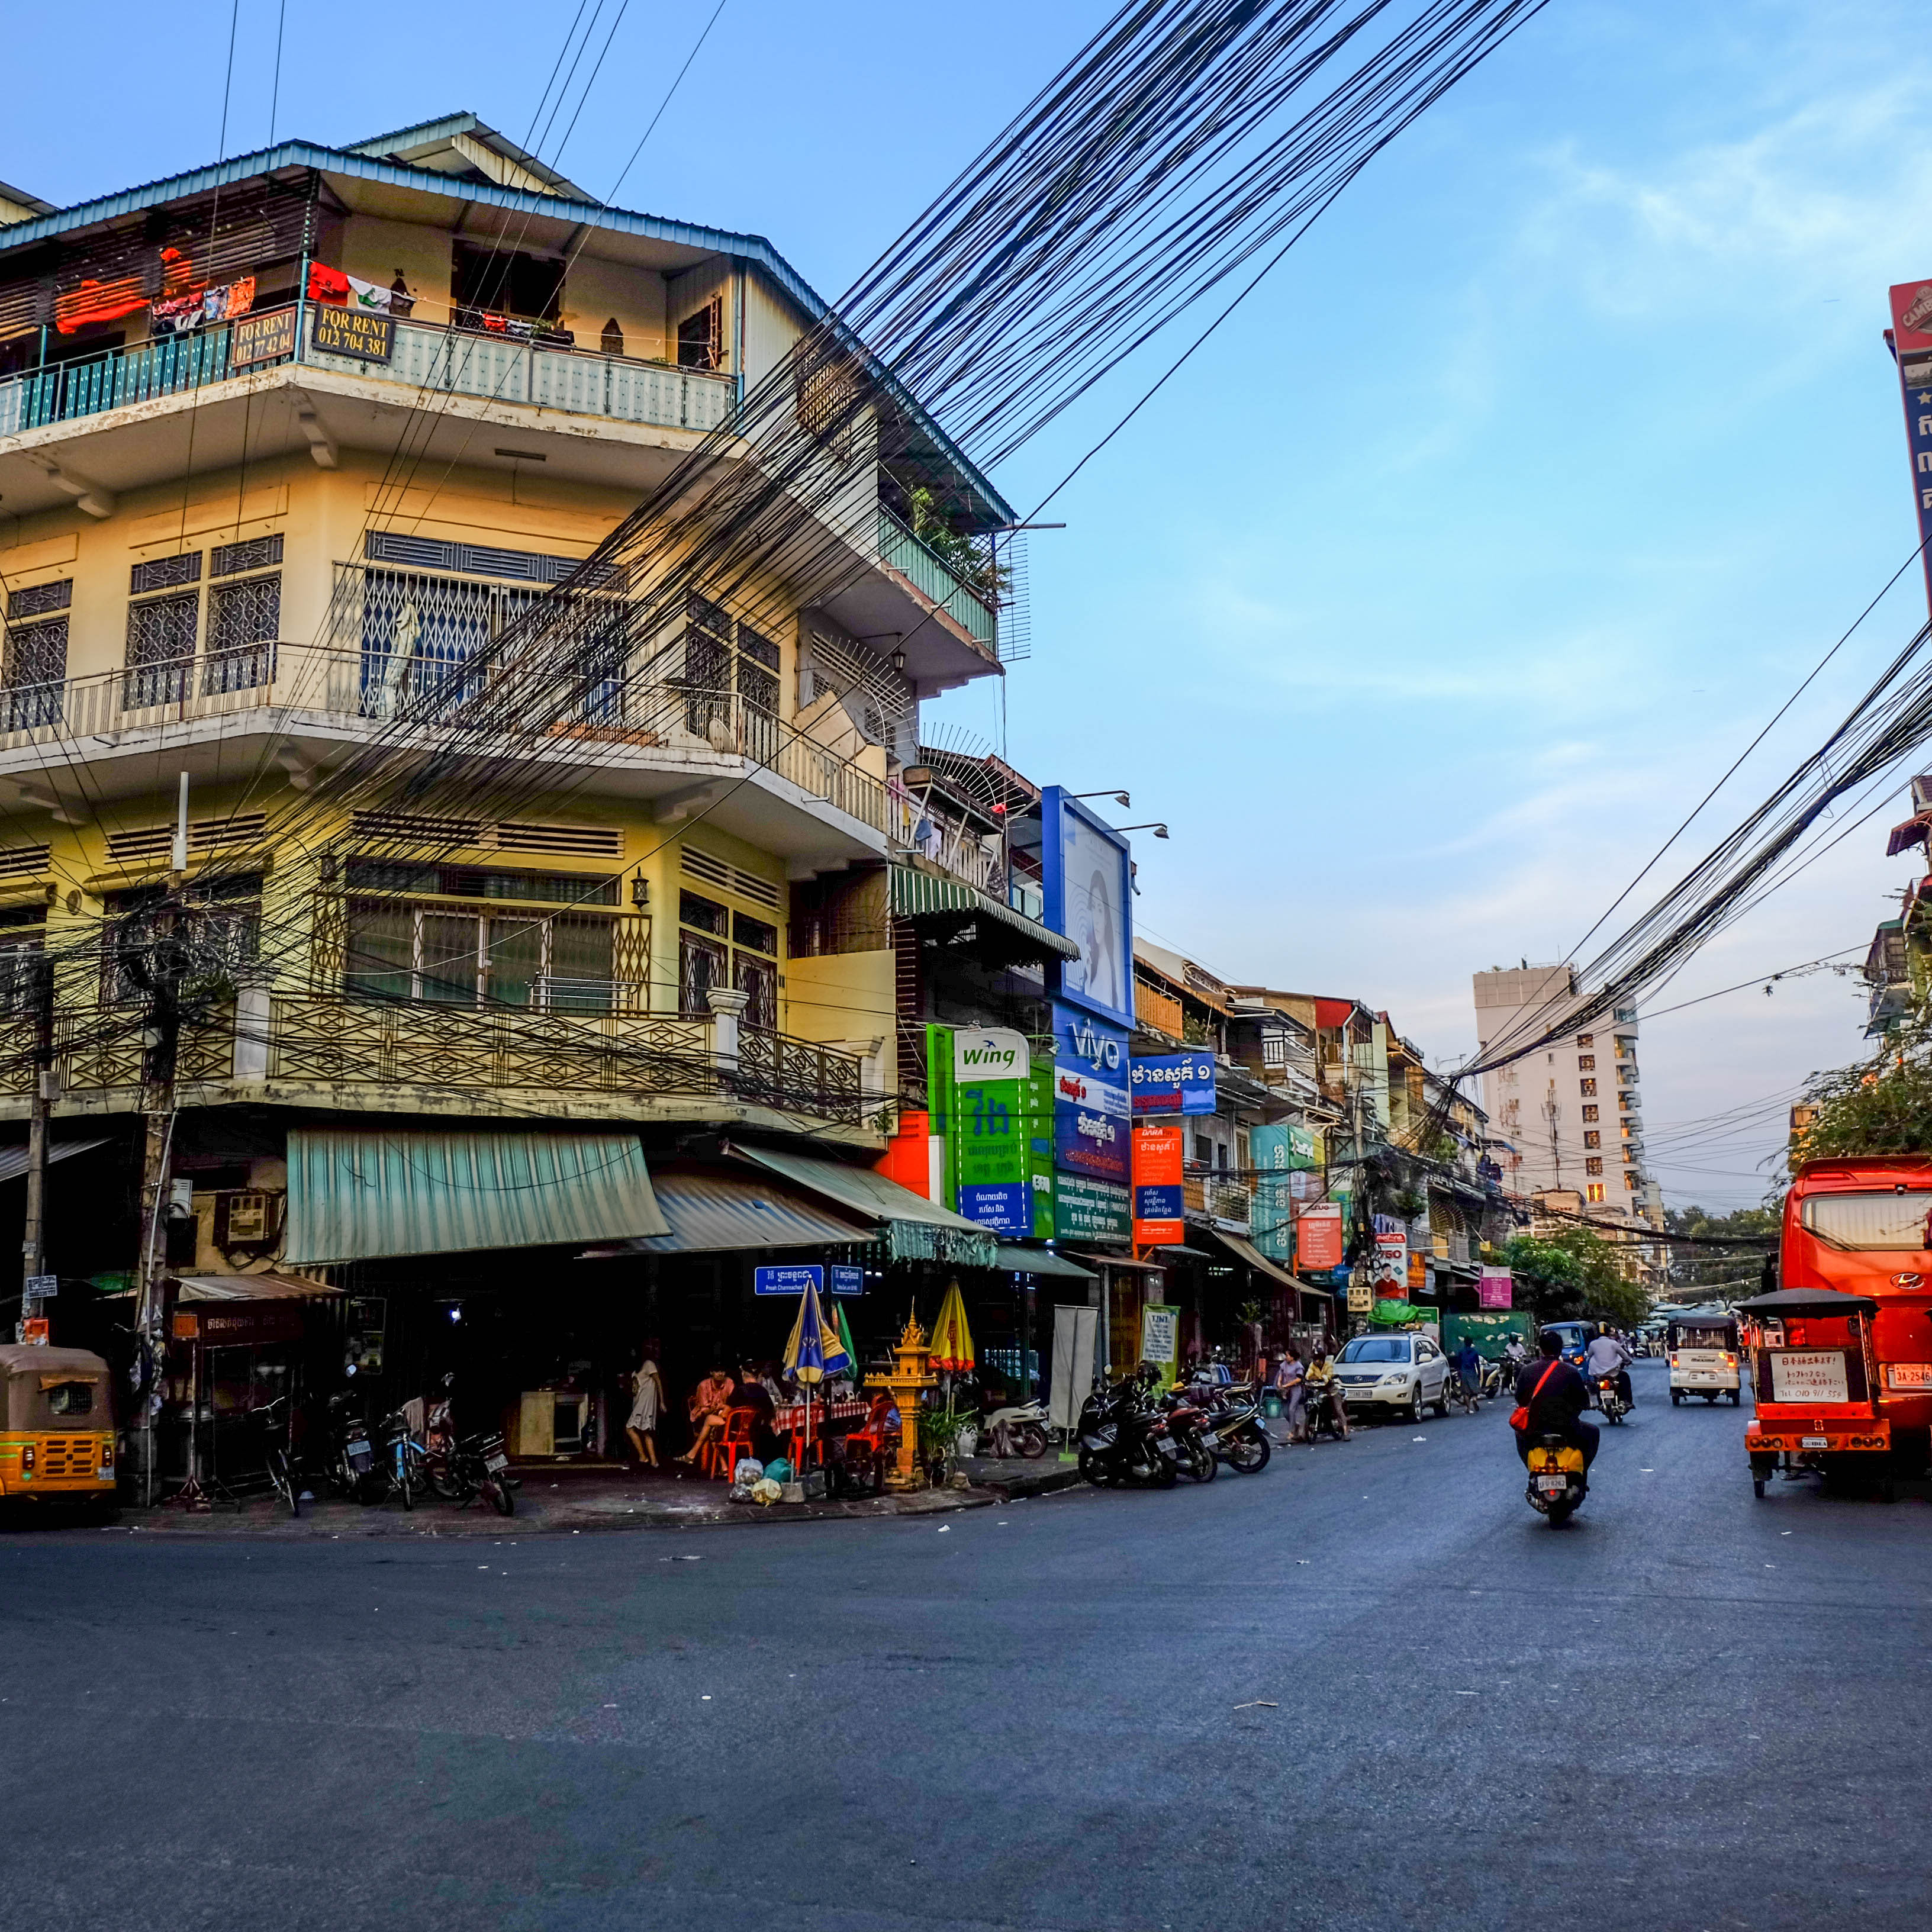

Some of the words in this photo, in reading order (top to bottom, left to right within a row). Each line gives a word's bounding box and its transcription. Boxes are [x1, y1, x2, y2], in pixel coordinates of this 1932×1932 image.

[239, 321, 260, 343] FOR
[262, 313, 291, 336] RENT
[322, 308, 350, 329] FOR
[352, 316, 389, 338] RENT
[237, 346, 252, 362] 012
[255, 340, 266, 356] 77
[266, 335, 277, 353] 42
[279, 332, 290, 350] 04
[318, 327, 340, 346] 012
[343, 332, 363, 351] 704
[365, 338, 386, 356] 381
[1066, 1017, 1119, 1069] vivo
[963, 1048, 1016, 1070] Wing
